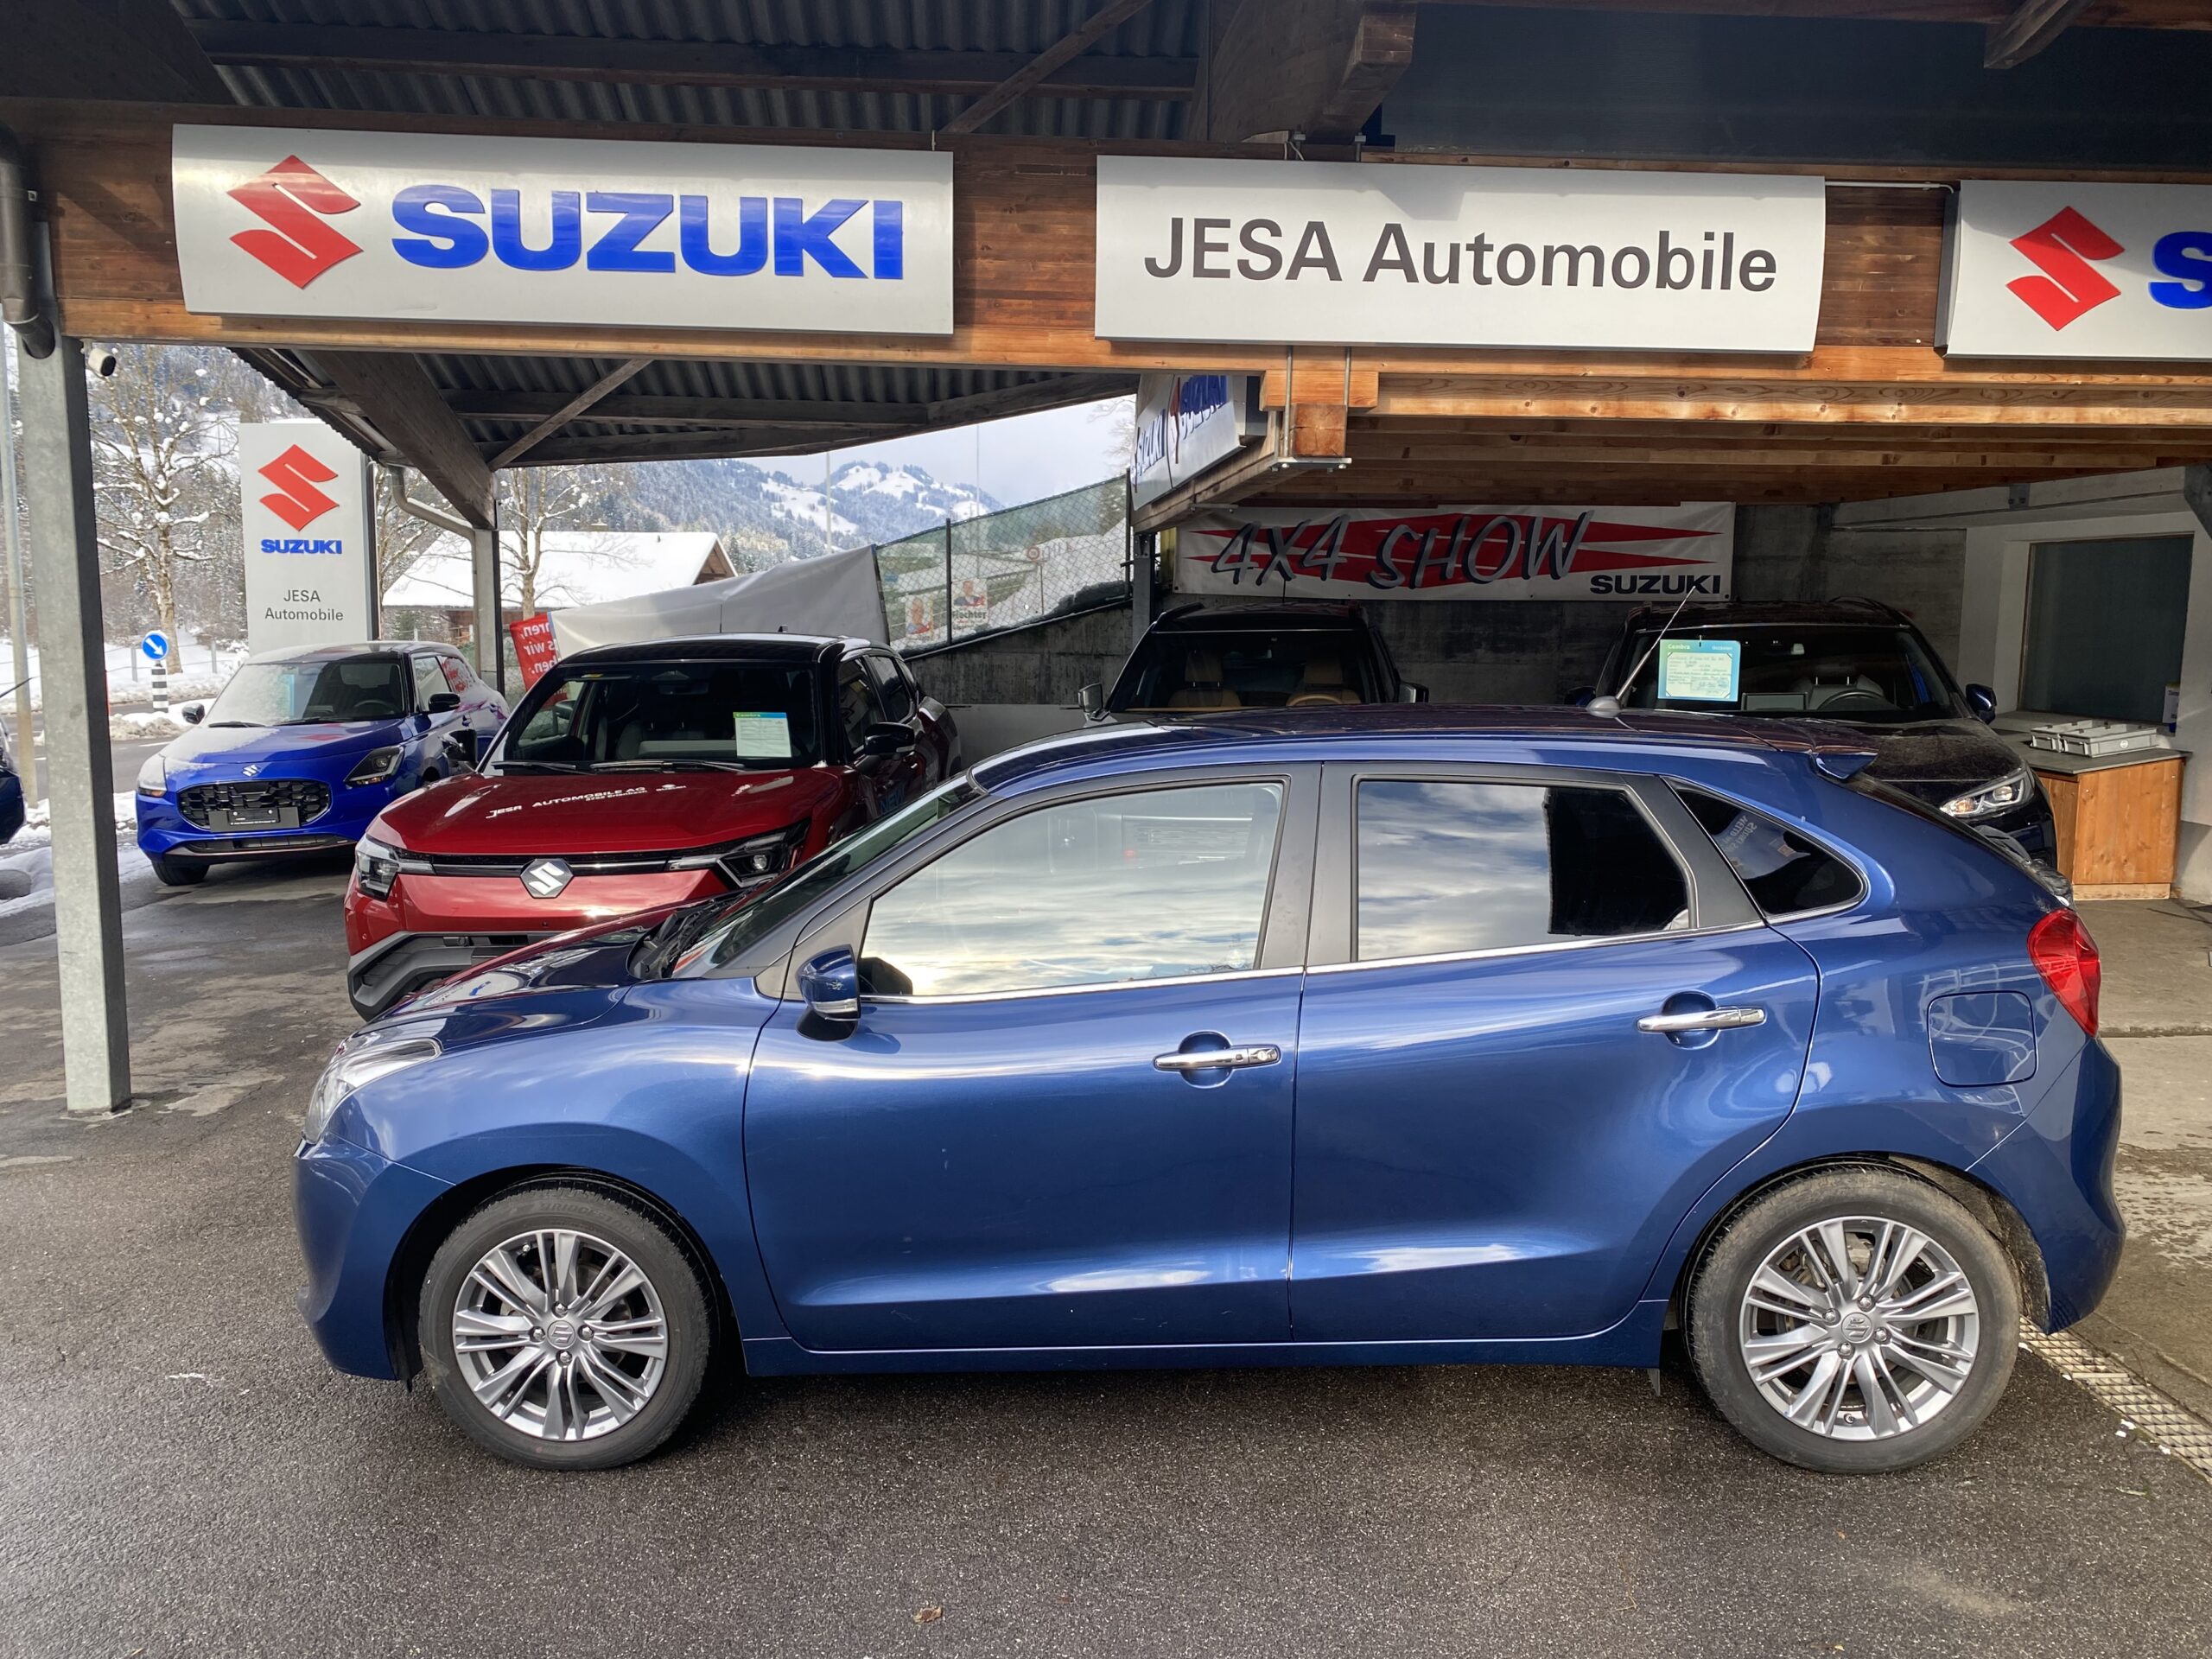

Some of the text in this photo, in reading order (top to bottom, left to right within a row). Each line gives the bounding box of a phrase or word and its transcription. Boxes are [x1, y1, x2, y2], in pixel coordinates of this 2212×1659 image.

[391, 183, 904, 280] SUZUKI
[1144, 217, 1778, 292] JESA Automobile
[261, 539, 343, 555] SUZUKI
[1366, 510, 1596, 589] SHOW
[283, 589, 321, 602] JESA
[1589, 575, 1721, 594] SUZUKI
[264, 607, 344, 621] Automobile
[486, 804, 522, 819] JESA
[532, 789, 622, 807] AUTOMOBILE
